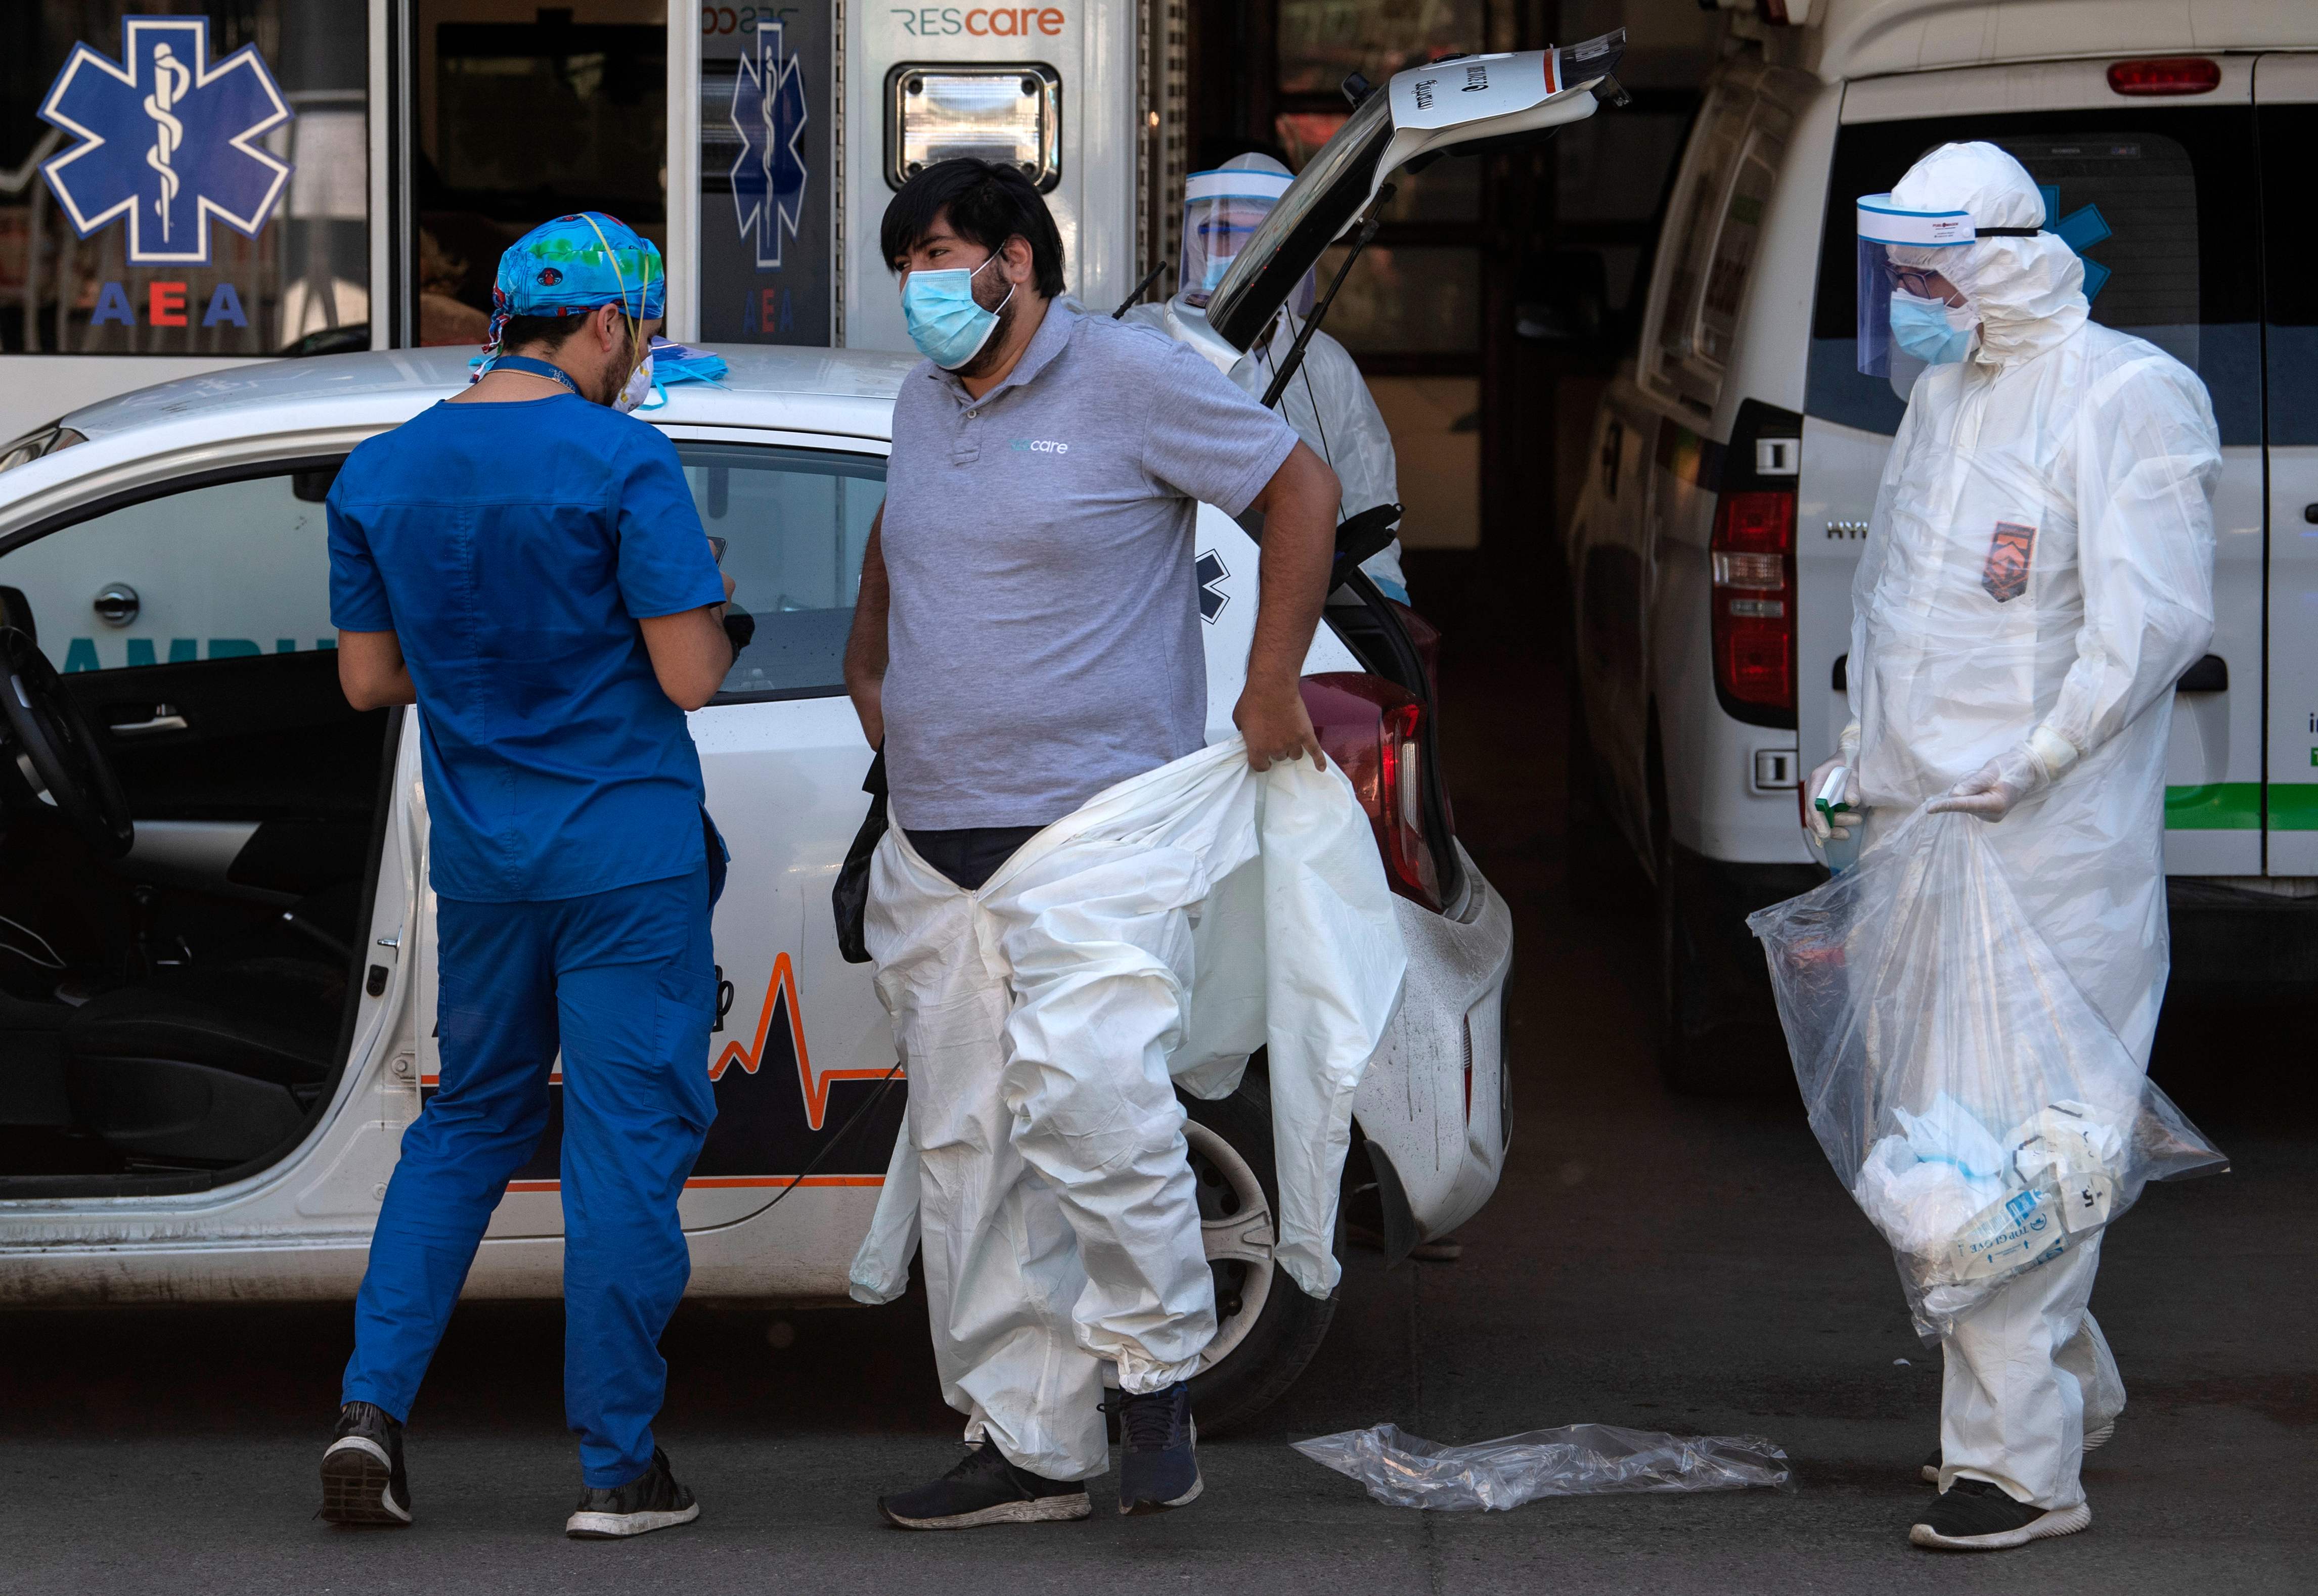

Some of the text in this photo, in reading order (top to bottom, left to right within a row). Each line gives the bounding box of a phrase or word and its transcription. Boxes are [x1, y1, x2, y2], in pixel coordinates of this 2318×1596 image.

[890, 7, 1065, 36] REScare
[92, 282, 248, 328] AEA
[742, 287, 794, 336] AEA
[2009, 1226, 2029, 1241] TOP
